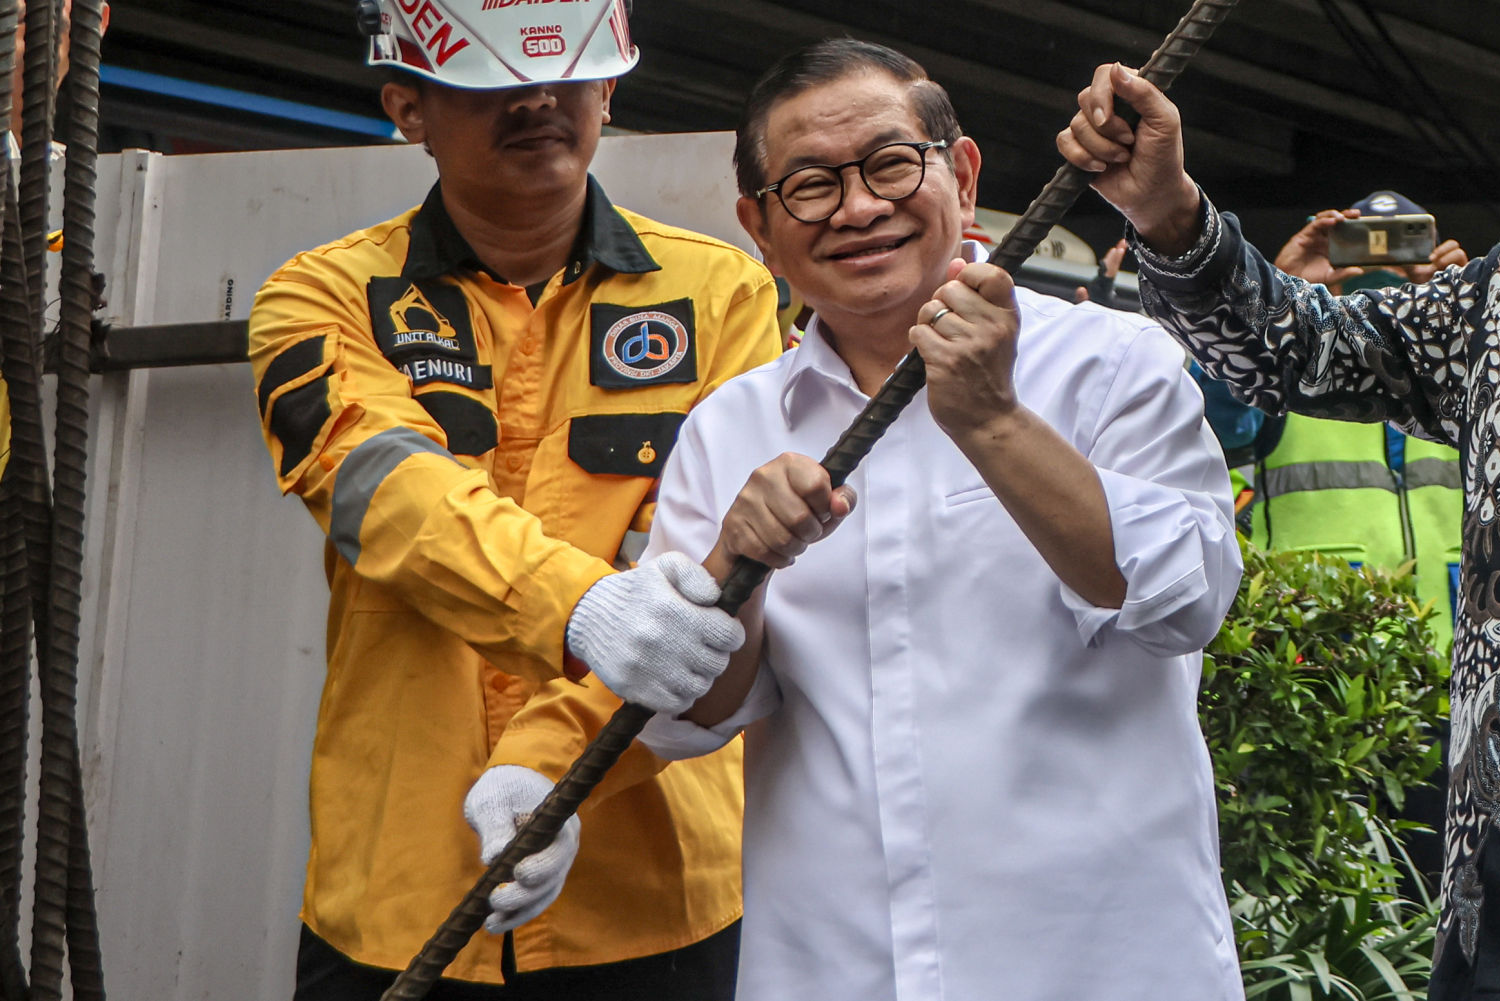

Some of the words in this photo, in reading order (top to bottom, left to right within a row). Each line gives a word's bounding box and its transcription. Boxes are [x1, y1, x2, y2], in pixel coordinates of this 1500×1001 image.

[519, 24, 563, 36] KANNO
[525, 37, 563, 55] 500
[396, 331, 424, 344] UNIT
[399, 359, 473, 384] AENURI
